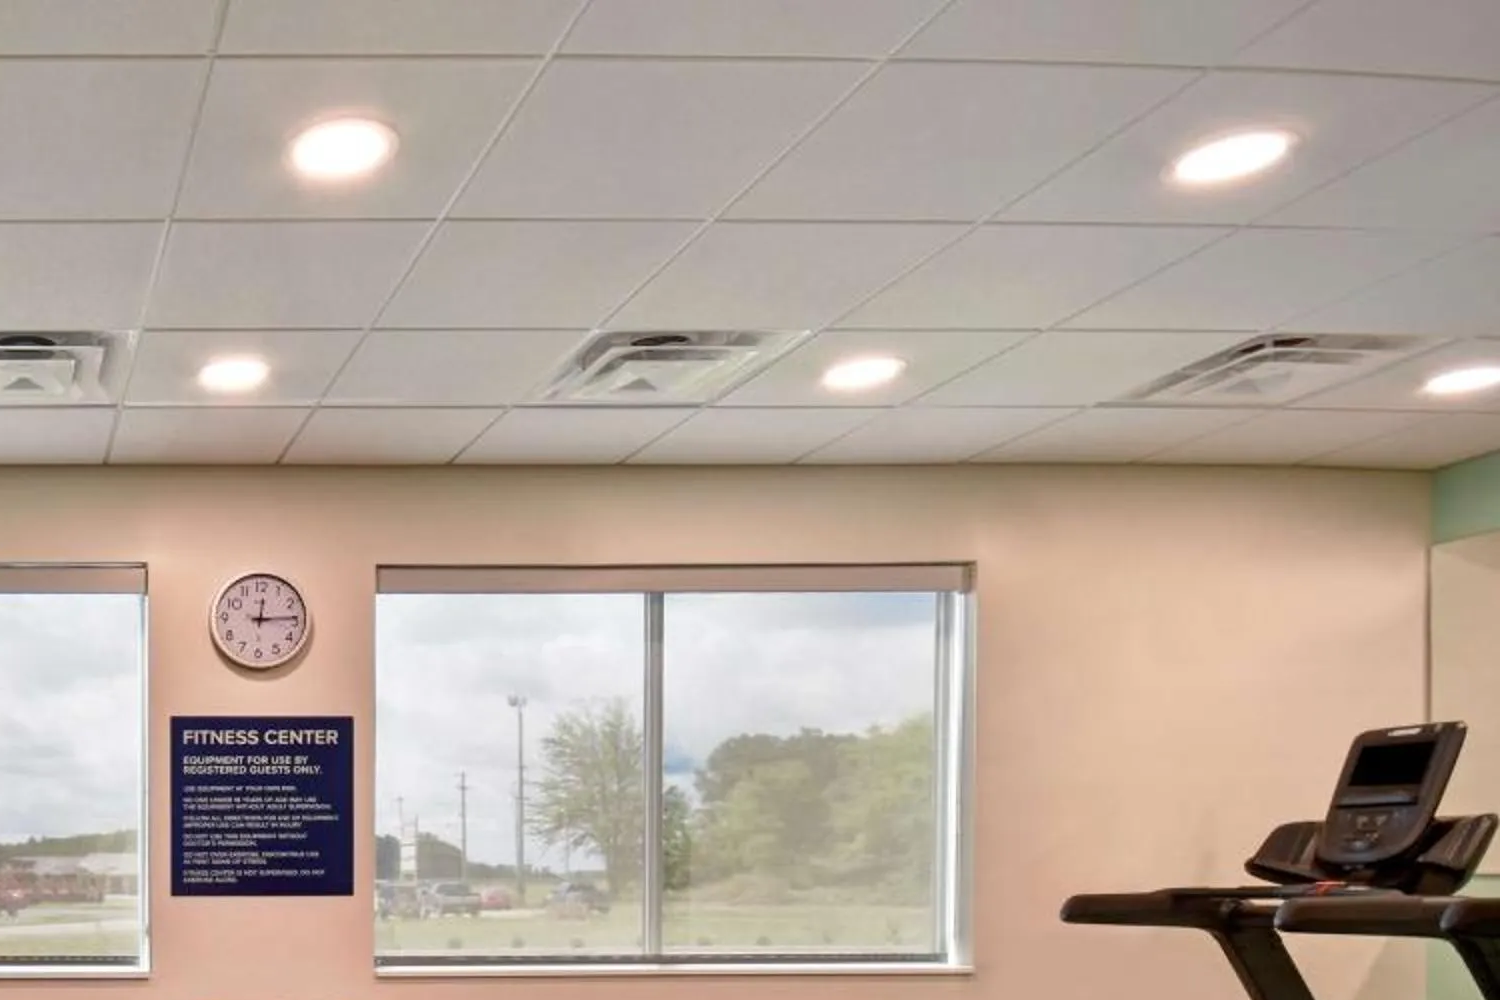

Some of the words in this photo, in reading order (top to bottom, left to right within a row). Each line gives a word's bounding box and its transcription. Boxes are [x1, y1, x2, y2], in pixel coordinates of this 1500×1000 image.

[240, 585, 249, 597] 11
[255, 581, 268, 593] 12
[227, 598, 243, 611] 10
[286, 597, 295, 609] 2
[284, 631, 293, 642] 4
[237, 641, 247, 653] 7
[183, 730, 259, 745] FITNESS
[264, 730, 339, 745] CENTER
[182, 755, 245, 766] EQUIPMENT
[247, 755, 269, 766] FOR
[271, 755, 293, 766] USE
[294, 755, 309, 766] BY
[182, 765, 248, 776] REGISTERED
[249, 765, 291, 776] GUESTS
